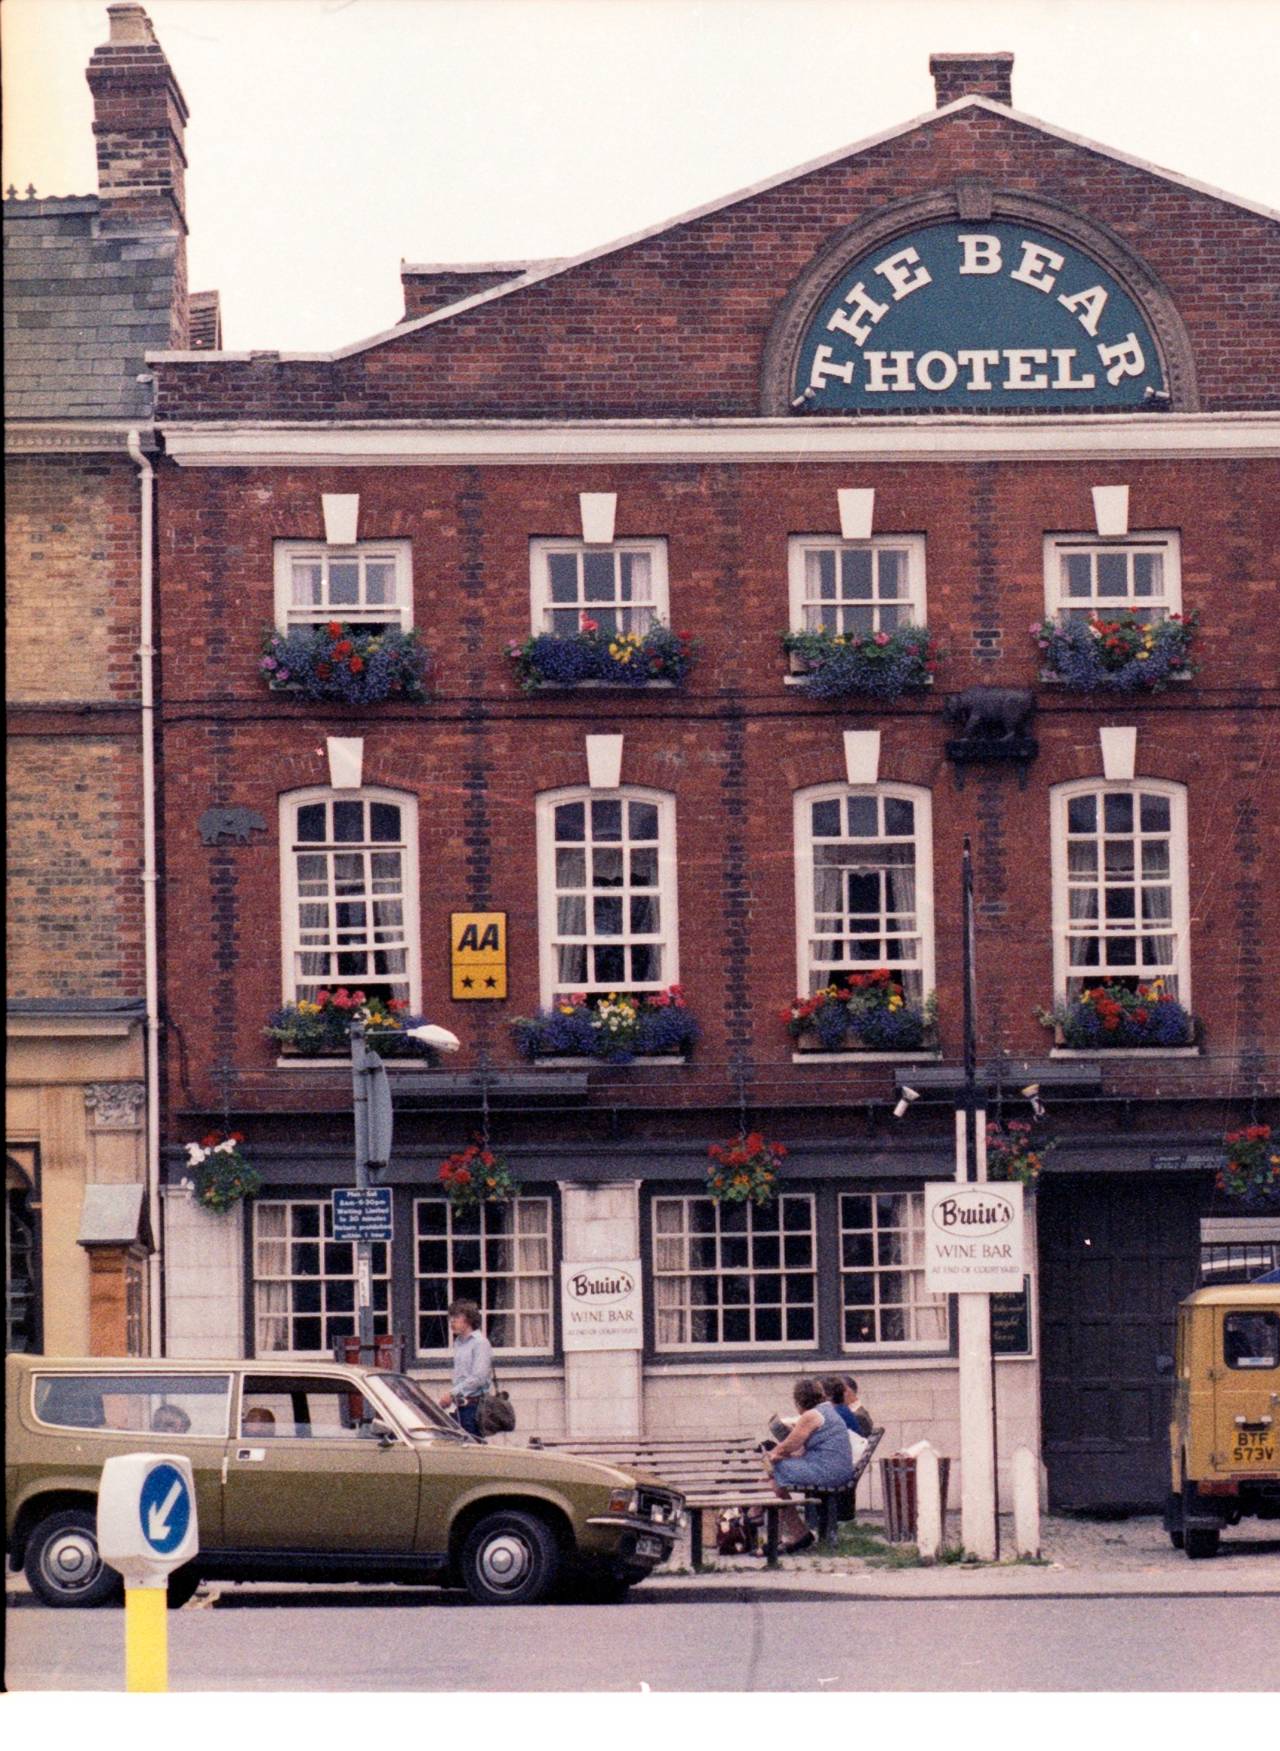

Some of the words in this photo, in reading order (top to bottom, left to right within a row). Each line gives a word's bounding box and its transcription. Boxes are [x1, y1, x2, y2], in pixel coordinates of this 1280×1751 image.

[809, 246, 933, 389] THE
[956, 233, 1147, 387] BEAR
[863, 348, 1096, 392] HOTEL
[457, 923, 500, 952] AA
[938, 1198, 1011, 1227] Bruin's
[935, 1244, 977, 1259] WINE
[981, 1243, 1013, 1259] BAR
[571, 1274, 632, 1297] Bruin's
[570, 1311, 604, 1323] WINE
[607, 1310, 634, 1322] BAR
[1237, 1432, 1269, 1447] BTF
[1232, 1446, 1274, 1461] 573V
